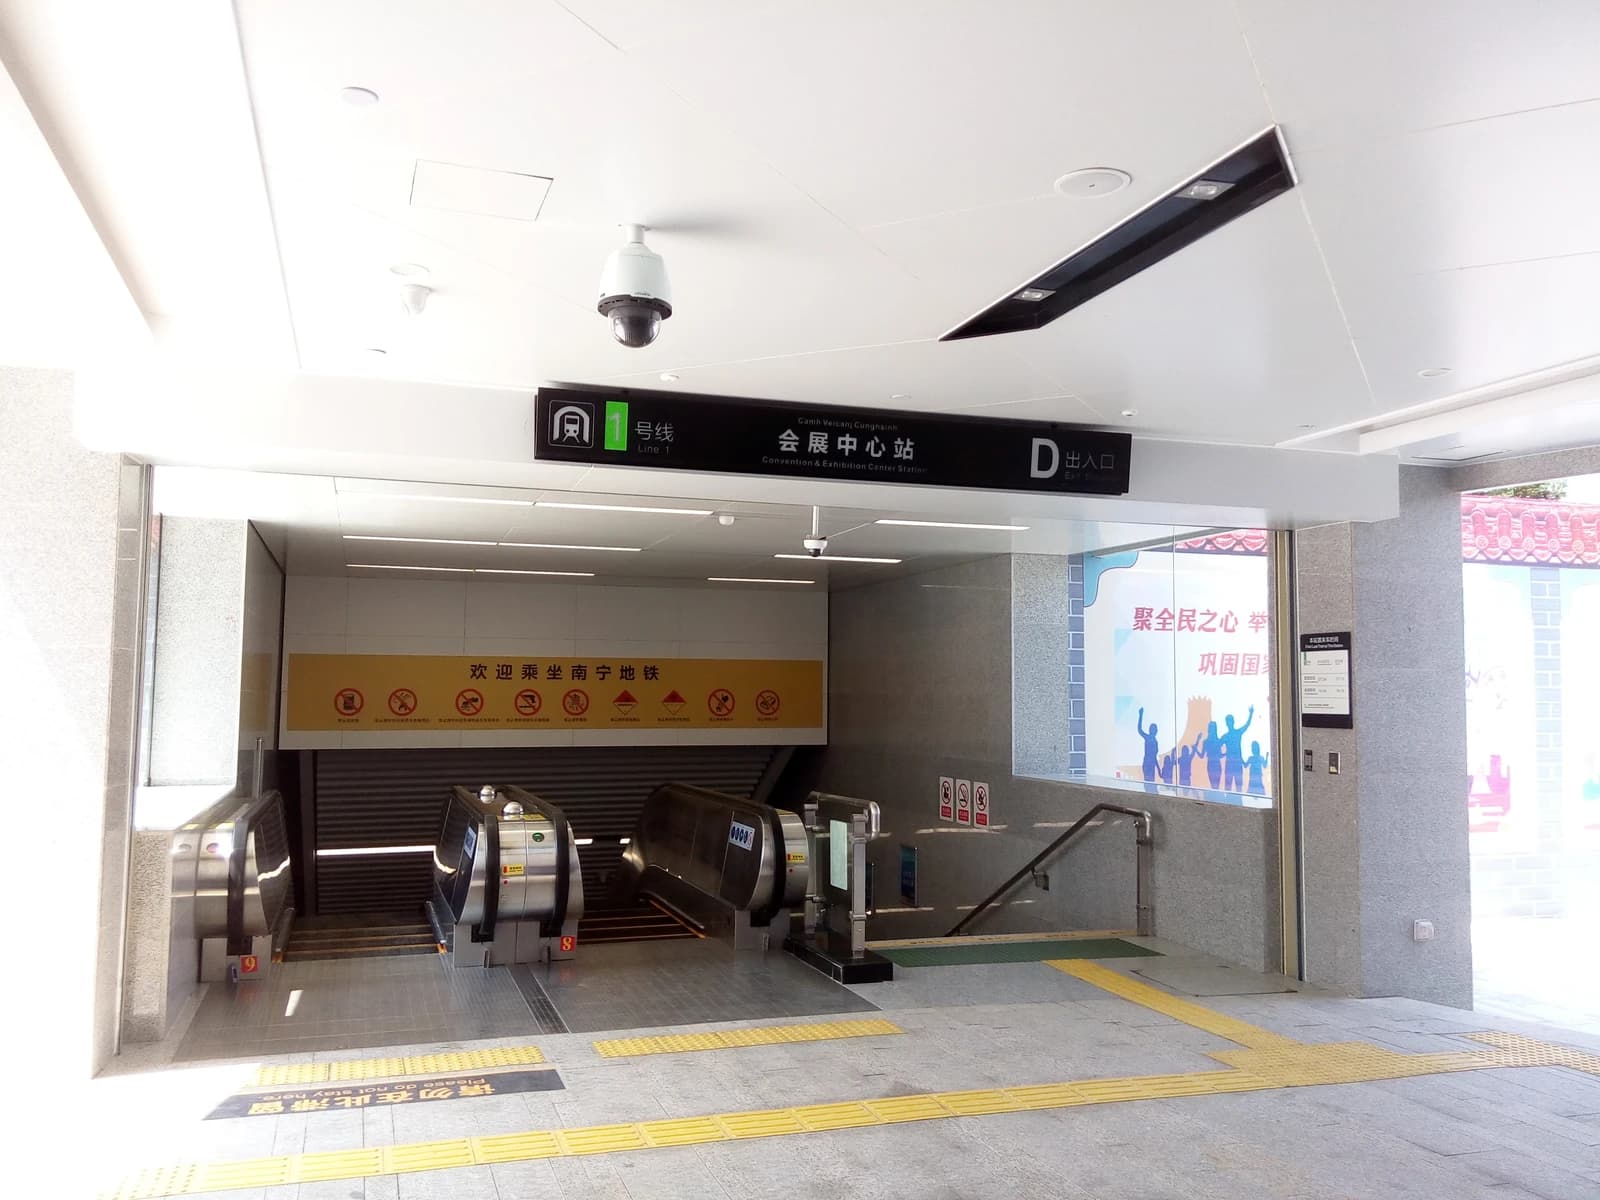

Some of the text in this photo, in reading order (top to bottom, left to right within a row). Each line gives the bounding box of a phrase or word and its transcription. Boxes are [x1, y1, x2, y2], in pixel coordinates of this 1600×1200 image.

[635, 421, 674, 442] 号线
[638, 444, 660, 455] Line
[778, 428, 915, 460] 会展中心站
[762, 455, 813, 467] Convention
[822, 459, 867, 471] Exhibition
[1030, 437, 1060, 479] D
[1065, 450, 1114, 470] 出入口
[1133, 607, 1239, 633] 聚全民之心
[470, 663, 660, 681] 欢迎乘坐南宁地铁
[563, 937, 571, 950] 8
[245, 957, 256, 971] 9
[424, 1078, 486, 1087] Please
[248, 1083, 496, 1115] 请勿在此滞留
[313, 1089, 352, 1097] stay
